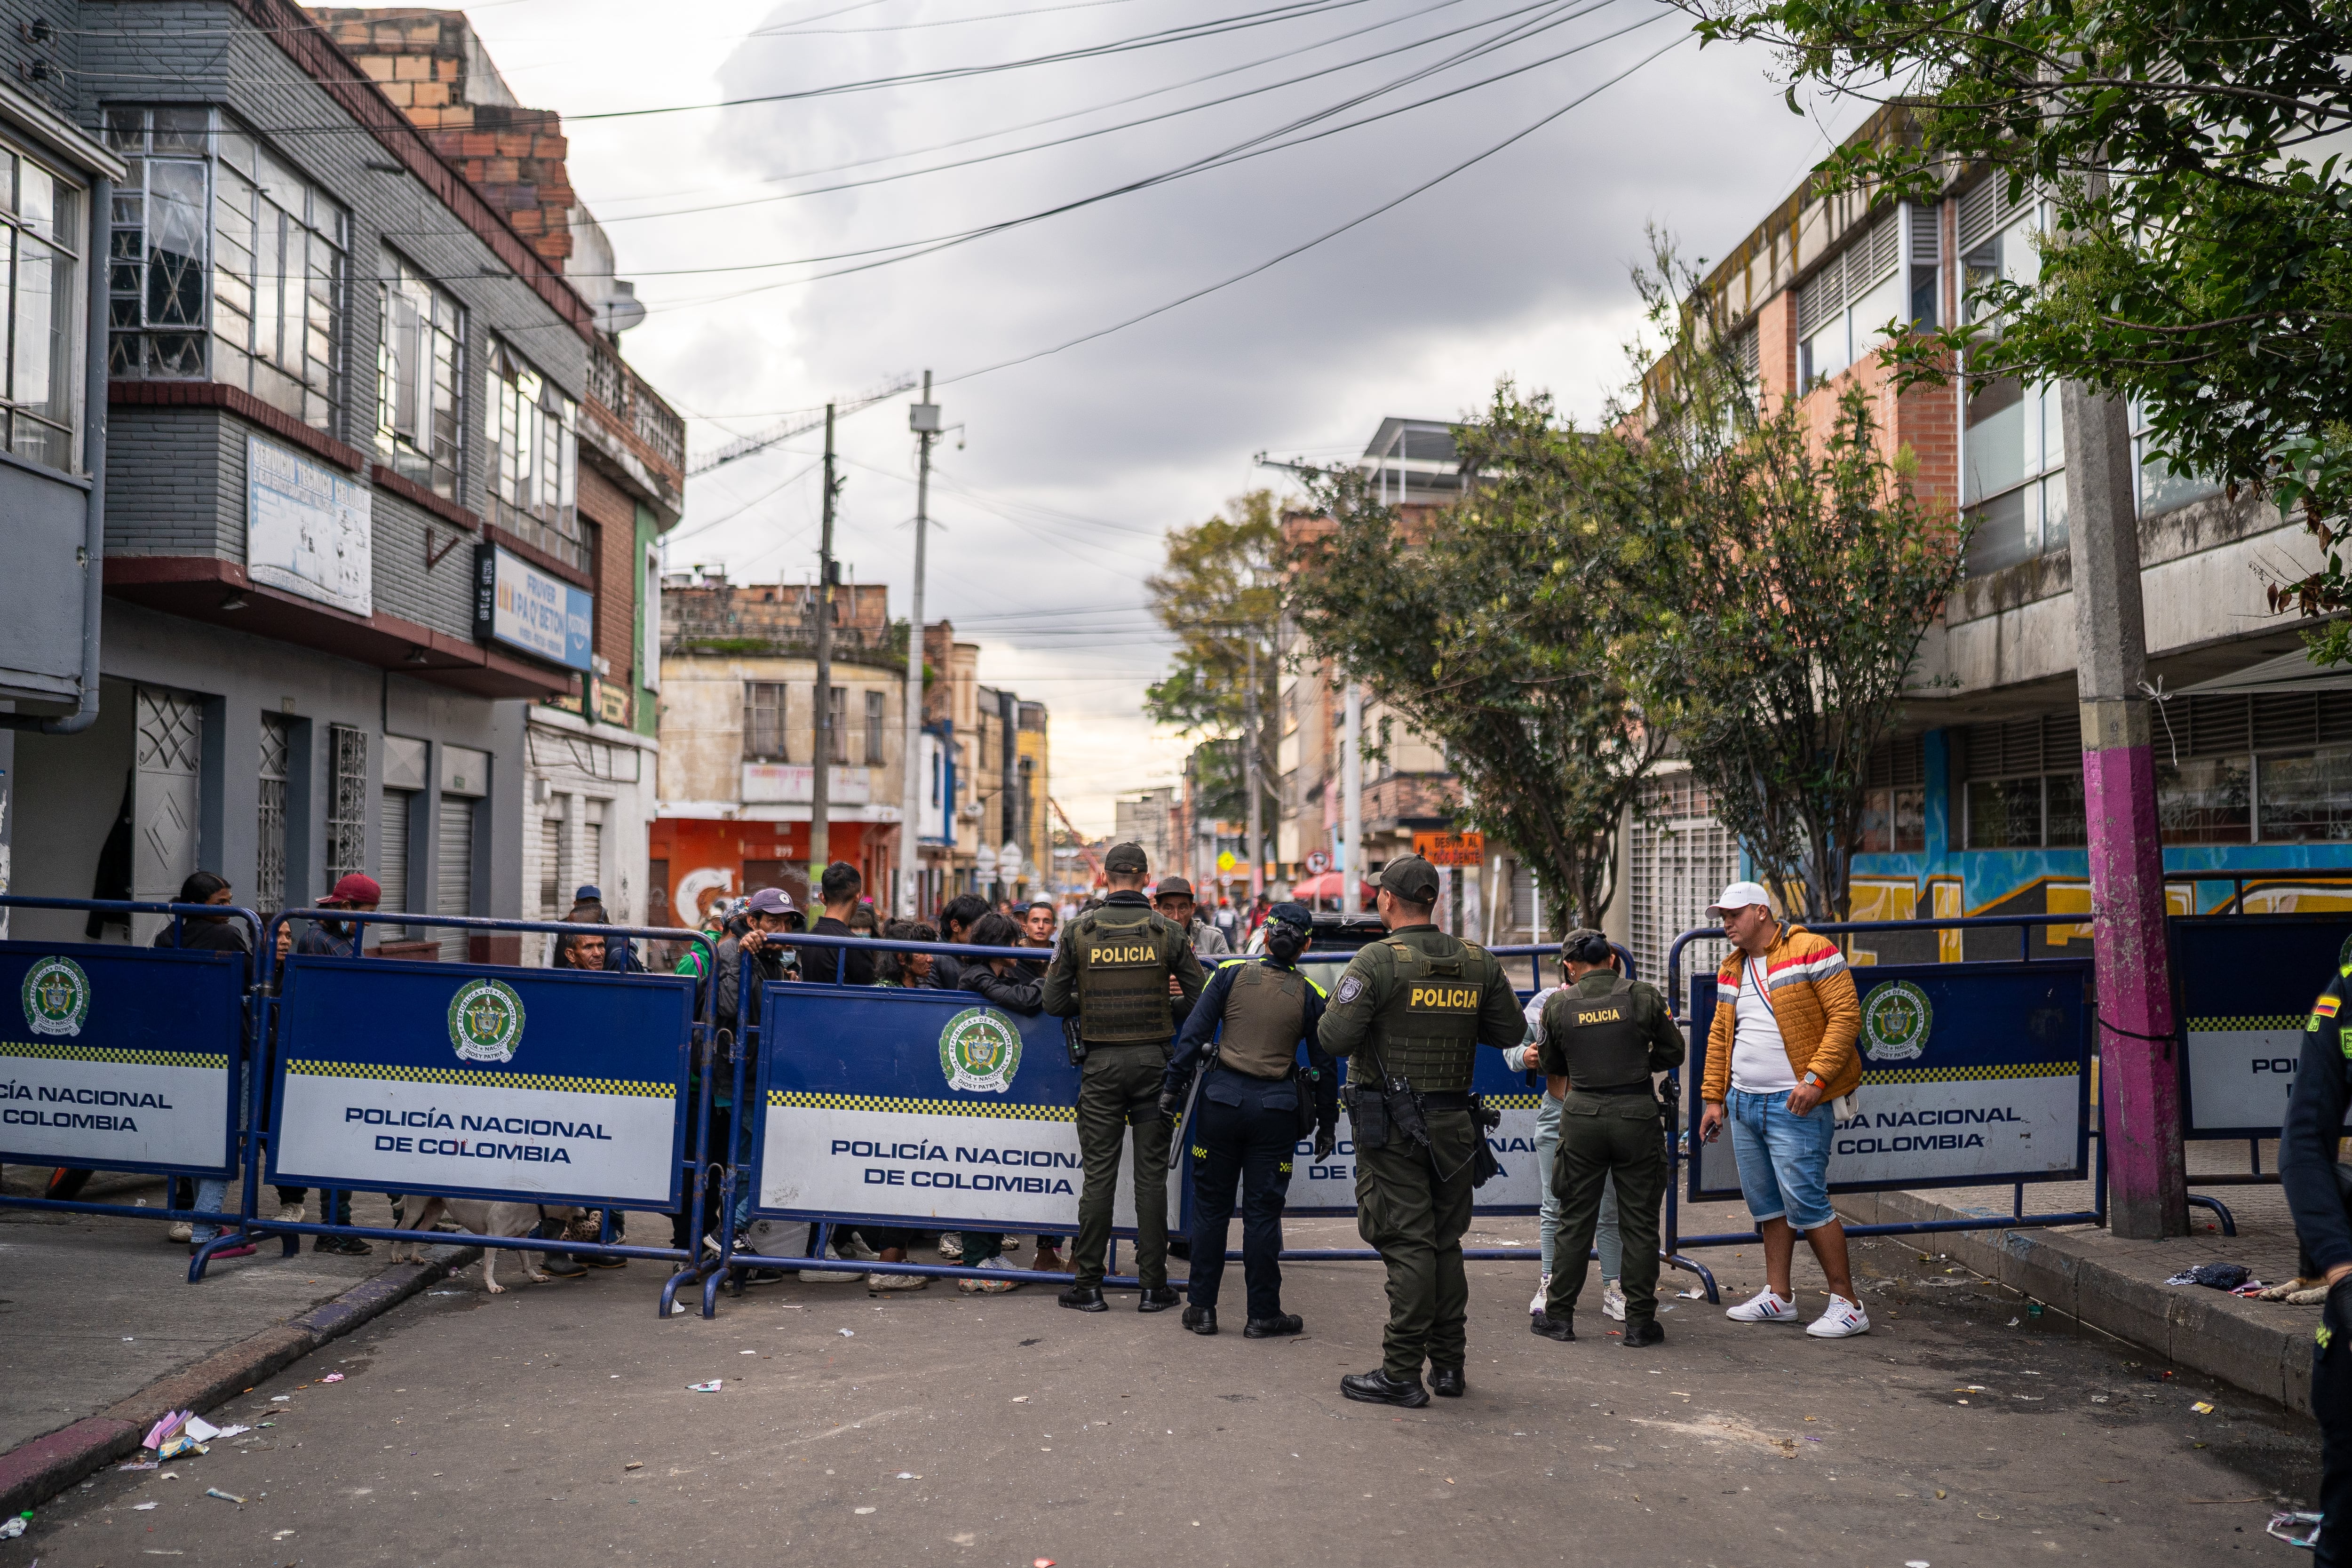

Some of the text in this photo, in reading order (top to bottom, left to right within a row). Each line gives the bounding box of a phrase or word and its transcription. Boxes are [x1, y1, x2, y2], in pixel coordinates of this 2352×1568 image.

[253, 441, 295, 481] SERVICIO
[1091, 946, 1156, 963] POLICIA
[31, 968, 50, 999] REPUBLICA
[67, 970, 82, 1002] COLOMBIA
[458, 991, 480, 1023] REPUBLICA
[499, 993, 516, 1027] COLOMBIA
[1411, 988, 1477, 1008] POLICIA
[56, 1008, 80, 1026] NACIONAL
[1578, 1009, 1620, 1024] POLICIA
[1867, 993, 1887, 1027] REPUBLICA
[1906, 993, 1923, 1024] COLOMBIA
[56, 1025, 73, 1034] PATRIA
[950, 1020, 973, 1053] REPUBLICA
[993, 1022, 1012, 1056] COLOMBIA
[1895, 1030, 1921, 1051] NACIONAL
[485, 1033, 512, 1051] NACIONAL
[484, 1051, 504, 1059] PATRIA
[1894, 1048, 1914, 1059] PATRIA
[979, 1063, 1008, 1082] NACIONAL
[978, 1081, 1000, 1090] PATRIA
[39, 1087, 173, 1109] NACIONAL
[3, 1109, 138, 1132] COLOMBIA
[345, 1107, 612, 1140] POLICÍA NACIONAL
[1876, 1107, 2021, 1129] NACIONAL
[375, 1135, 572, 1164] DE COLOMBIA
[831, 1139, 949, 1162] POLICÍA
[1837, 1133, 1984, 1155] COLOMBIA
[864, 1168, 1074, 1195] DE COLOMBIA
[1309, 1165, 1347, 1180] DE
